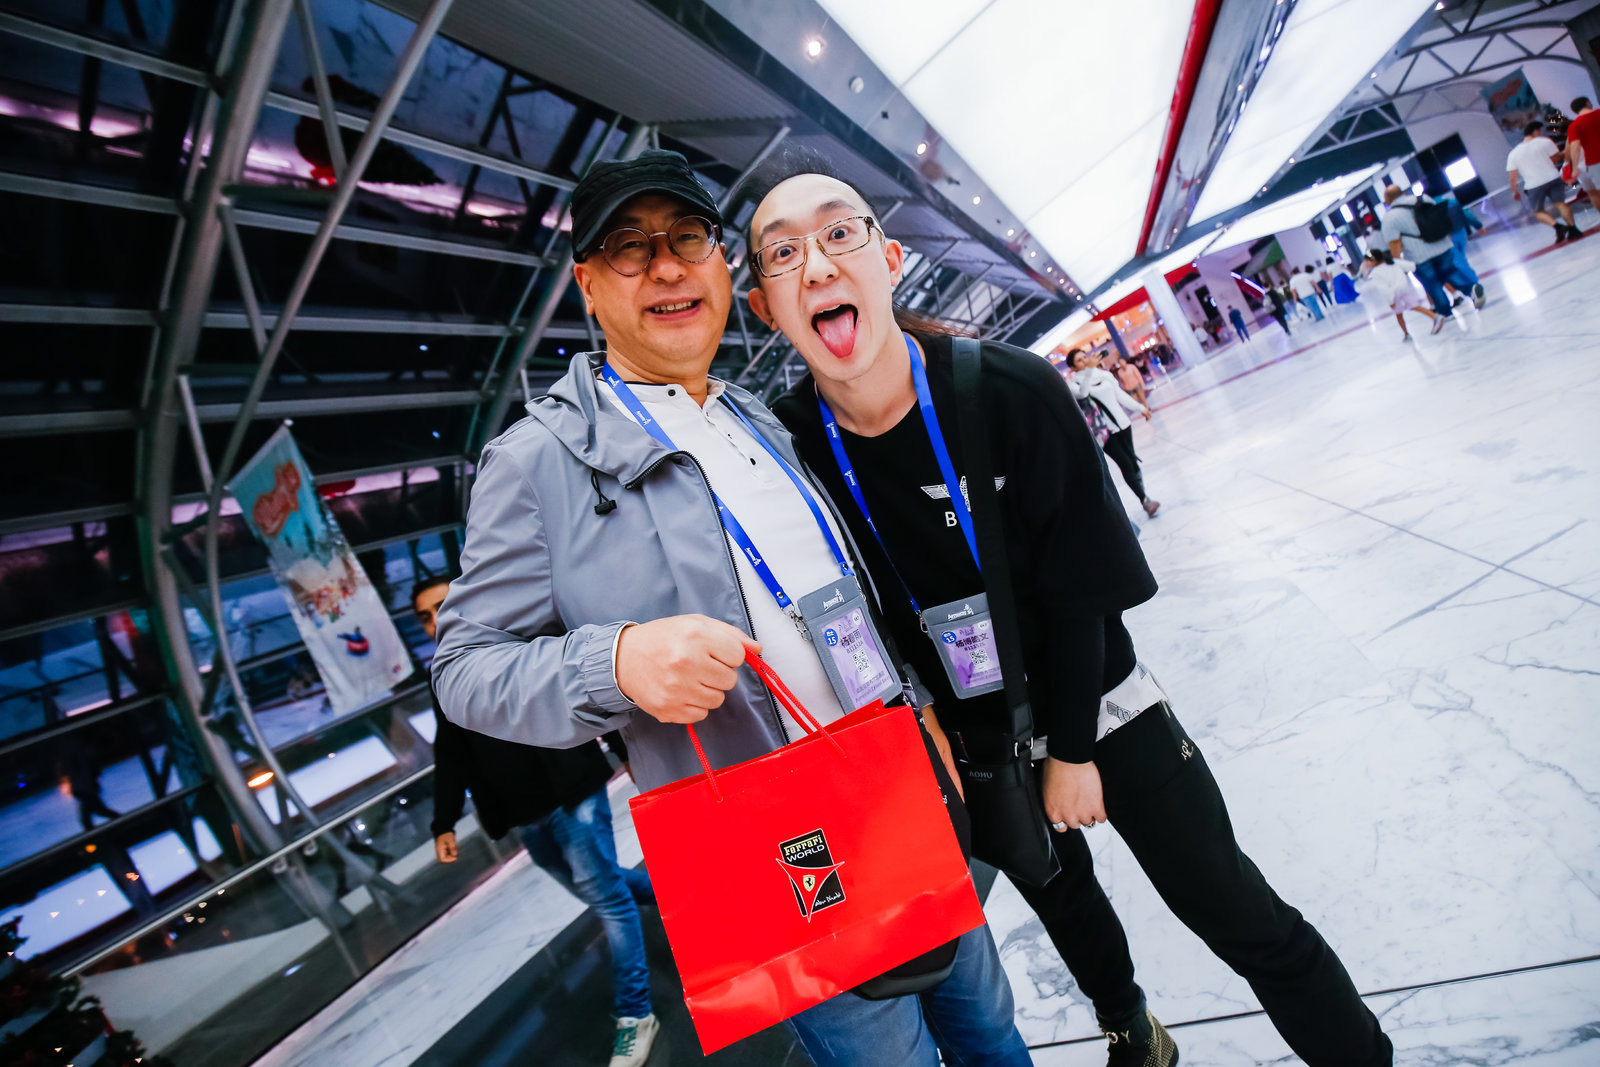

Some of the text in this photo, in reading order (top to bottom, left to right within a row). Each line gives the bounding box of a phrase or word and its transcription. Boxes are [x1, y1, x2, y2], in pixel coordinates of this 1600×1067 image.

[827, 637, 837, 645] 15
[945, 635, 955, 643] 15
[784, 835, 823, 856] Ferrari
[787, 844, 825, 862] WORLD
